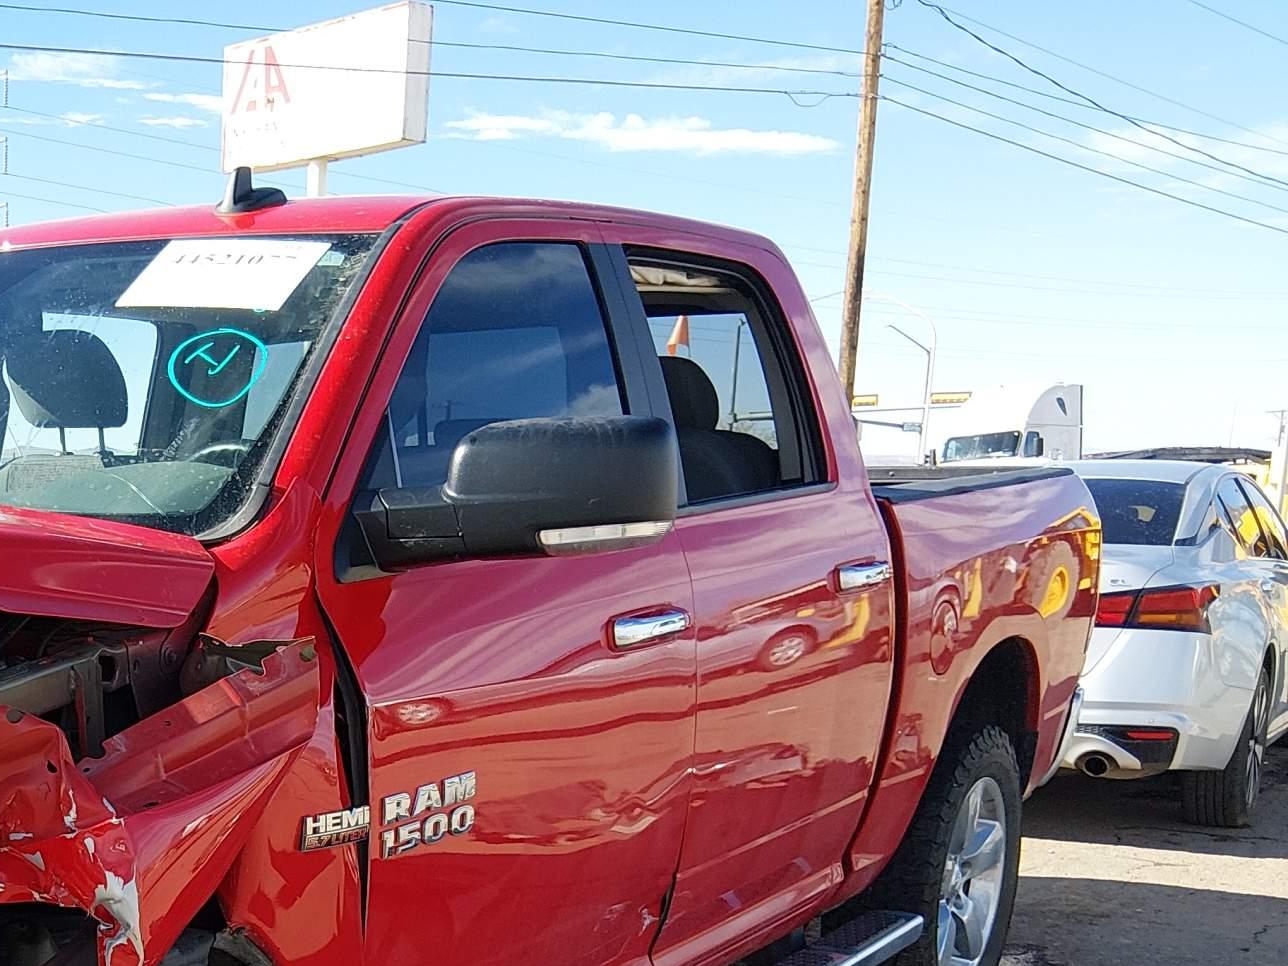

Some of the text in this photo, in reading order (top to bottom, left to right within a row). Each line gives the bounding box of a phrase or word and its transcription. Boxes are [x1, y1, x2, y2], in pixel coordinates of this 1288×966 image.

[383, 771, 476, 825] RAM
[305, 805, 370, 836] HEMI
[383, 804, 475, 860] 1500
[307, 835, 331, 849] 5.7
